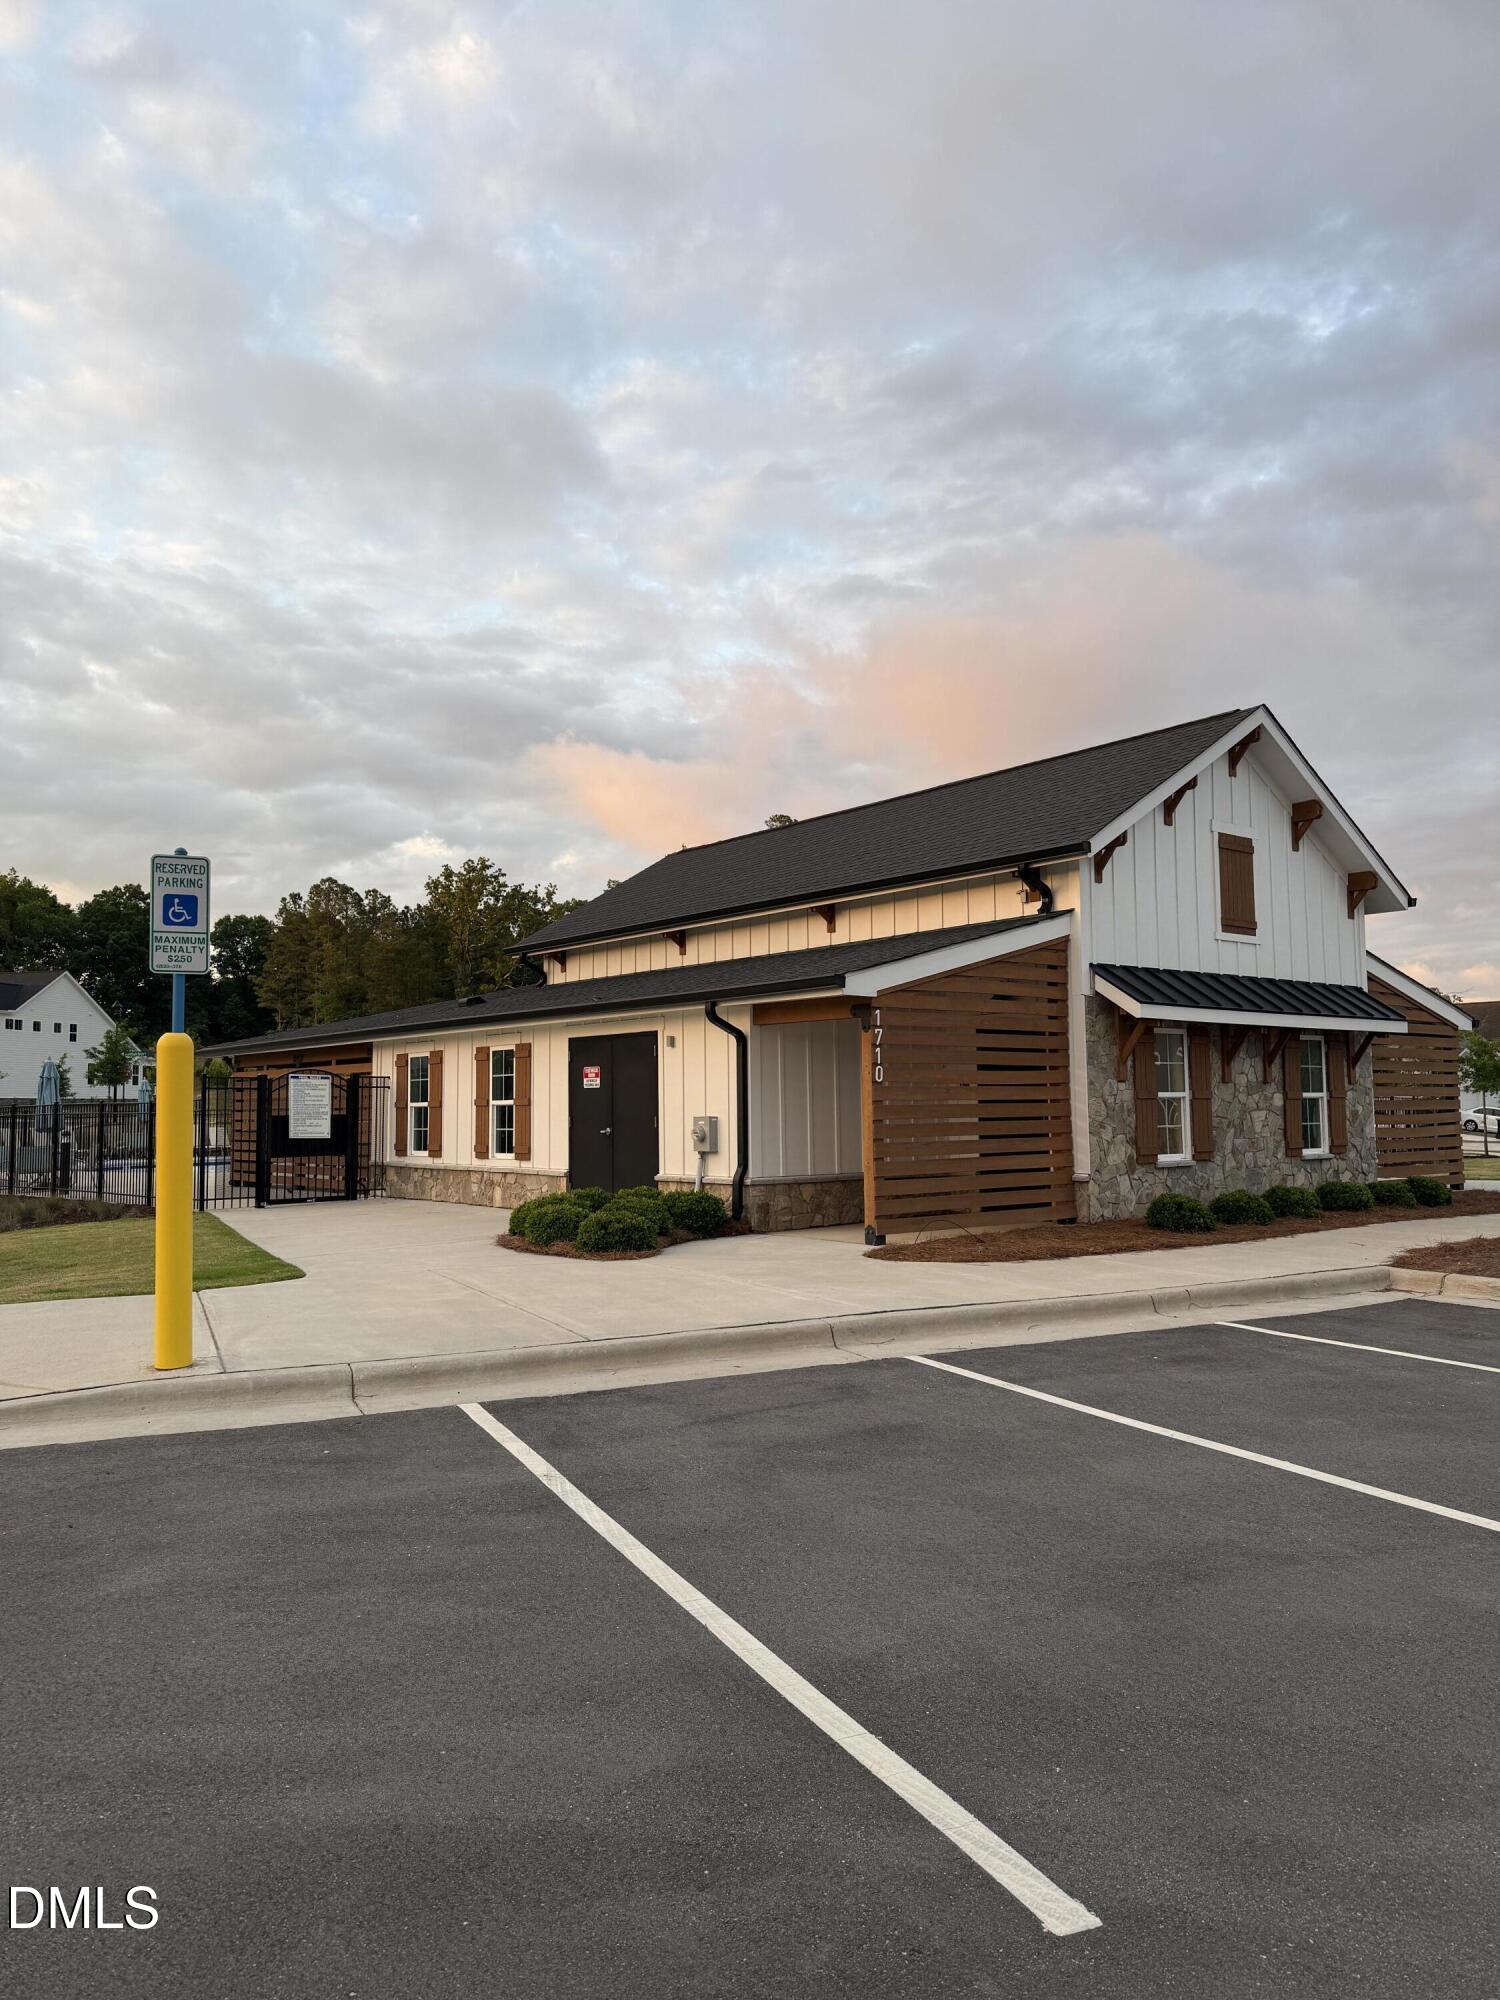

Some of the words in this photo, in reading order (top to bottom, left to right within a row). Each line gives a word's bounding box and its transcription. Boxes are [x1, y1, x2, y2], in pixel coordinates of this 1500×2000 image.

[155, 863, 206, 875] RESERVED
[157, 876, 204, 889] PARKING
[154, 935, 206, 945] MAXIMUM
[155, 945, 205, 954] PENALTY
[167, 955, 193, 963] $250
[874, 1009, 884, 1082] 1710
